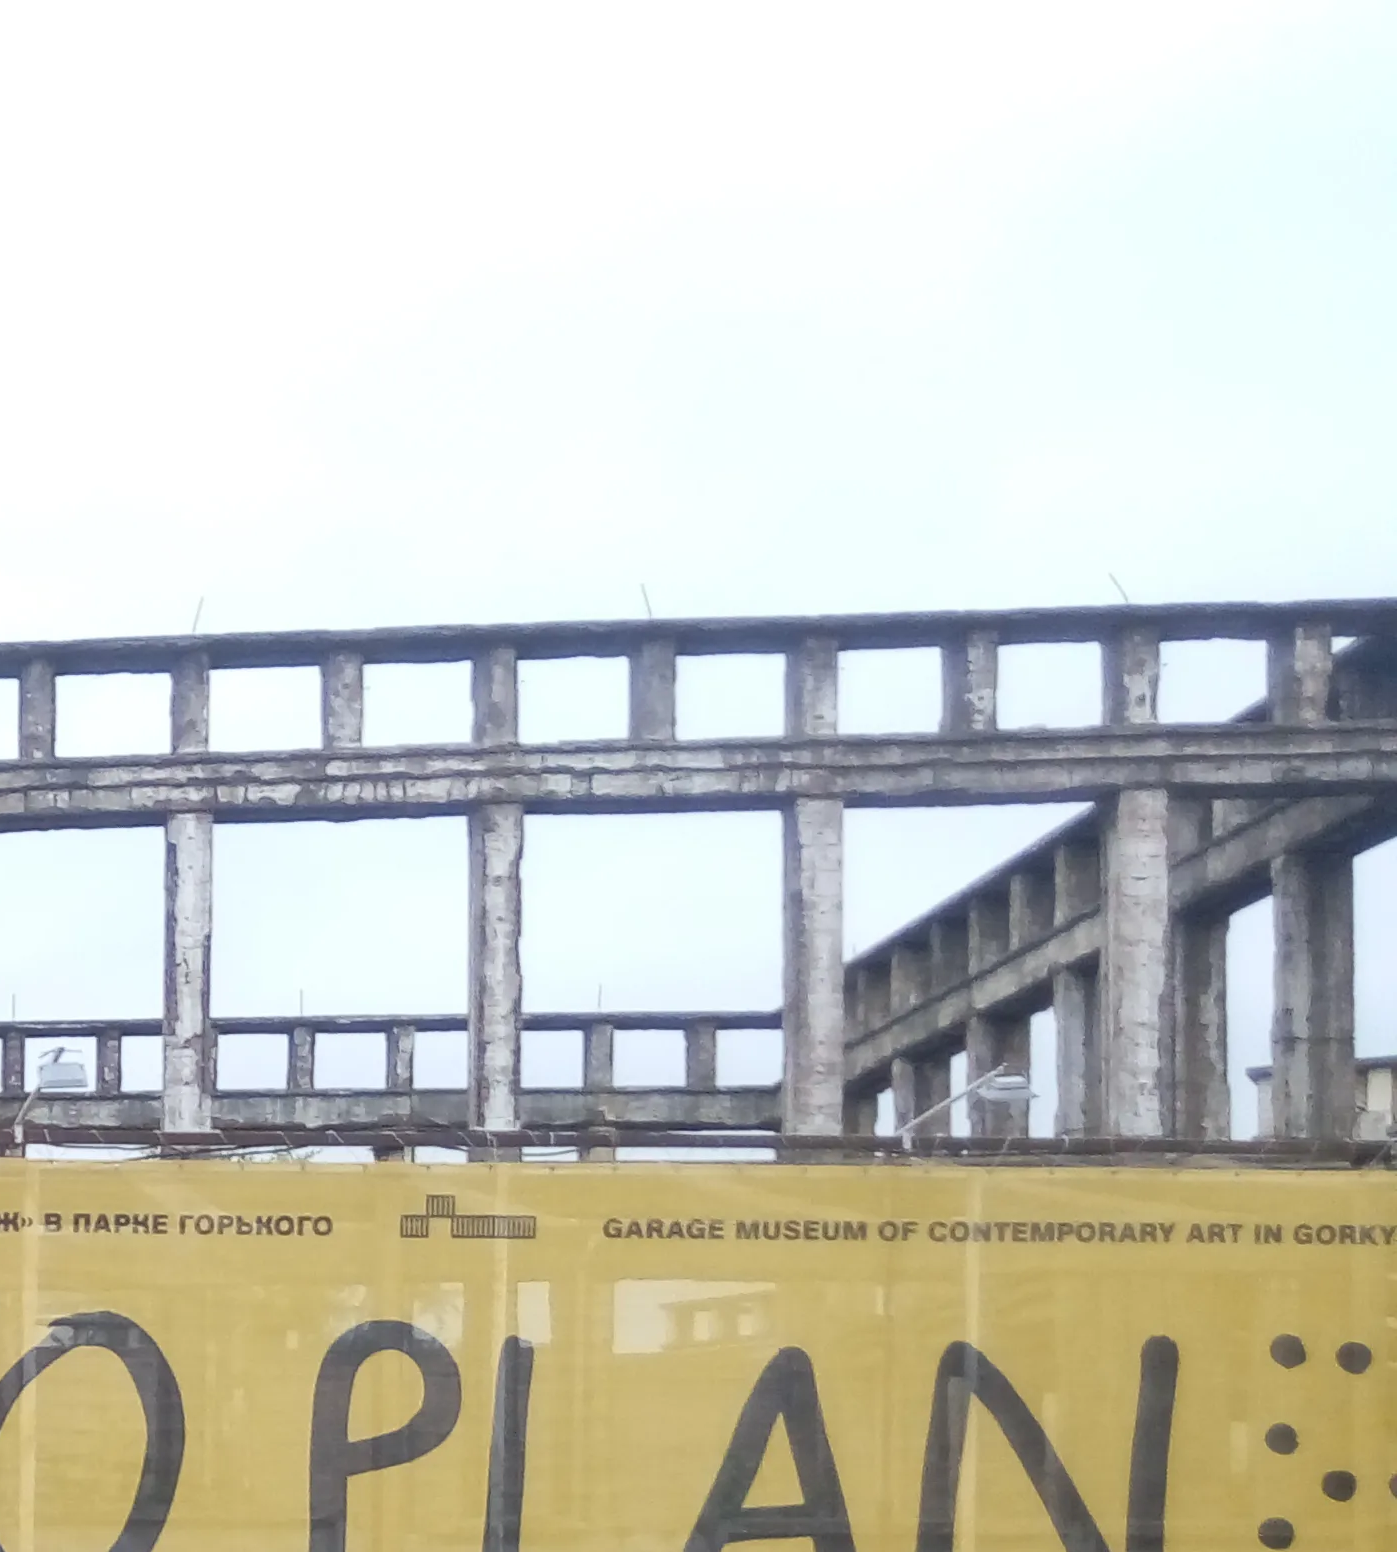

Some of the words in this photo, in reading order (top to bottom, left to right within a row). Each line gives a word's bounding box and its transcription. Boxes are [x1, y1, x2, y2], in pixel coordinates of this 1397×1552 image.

[43, 1212, 63, 1233] В
[72, 1213, 169, 1235] ПАРКЕ
[178, 1214, 334, 1237] ГОРЬКОГО
[602, 1217, 725, 1241] GARAGE
[735, 1219, 868, 1242] MUSEUM
[877, 1219, 920, 1243] OF
[928, 1219, 1175, 1244] CONTEMPORARY
[1186, 1222, 1244, 1244] ART
[1253, 1223, 1283, 1245] IN
[1292, 1223, 1396, 1246] GORKY
